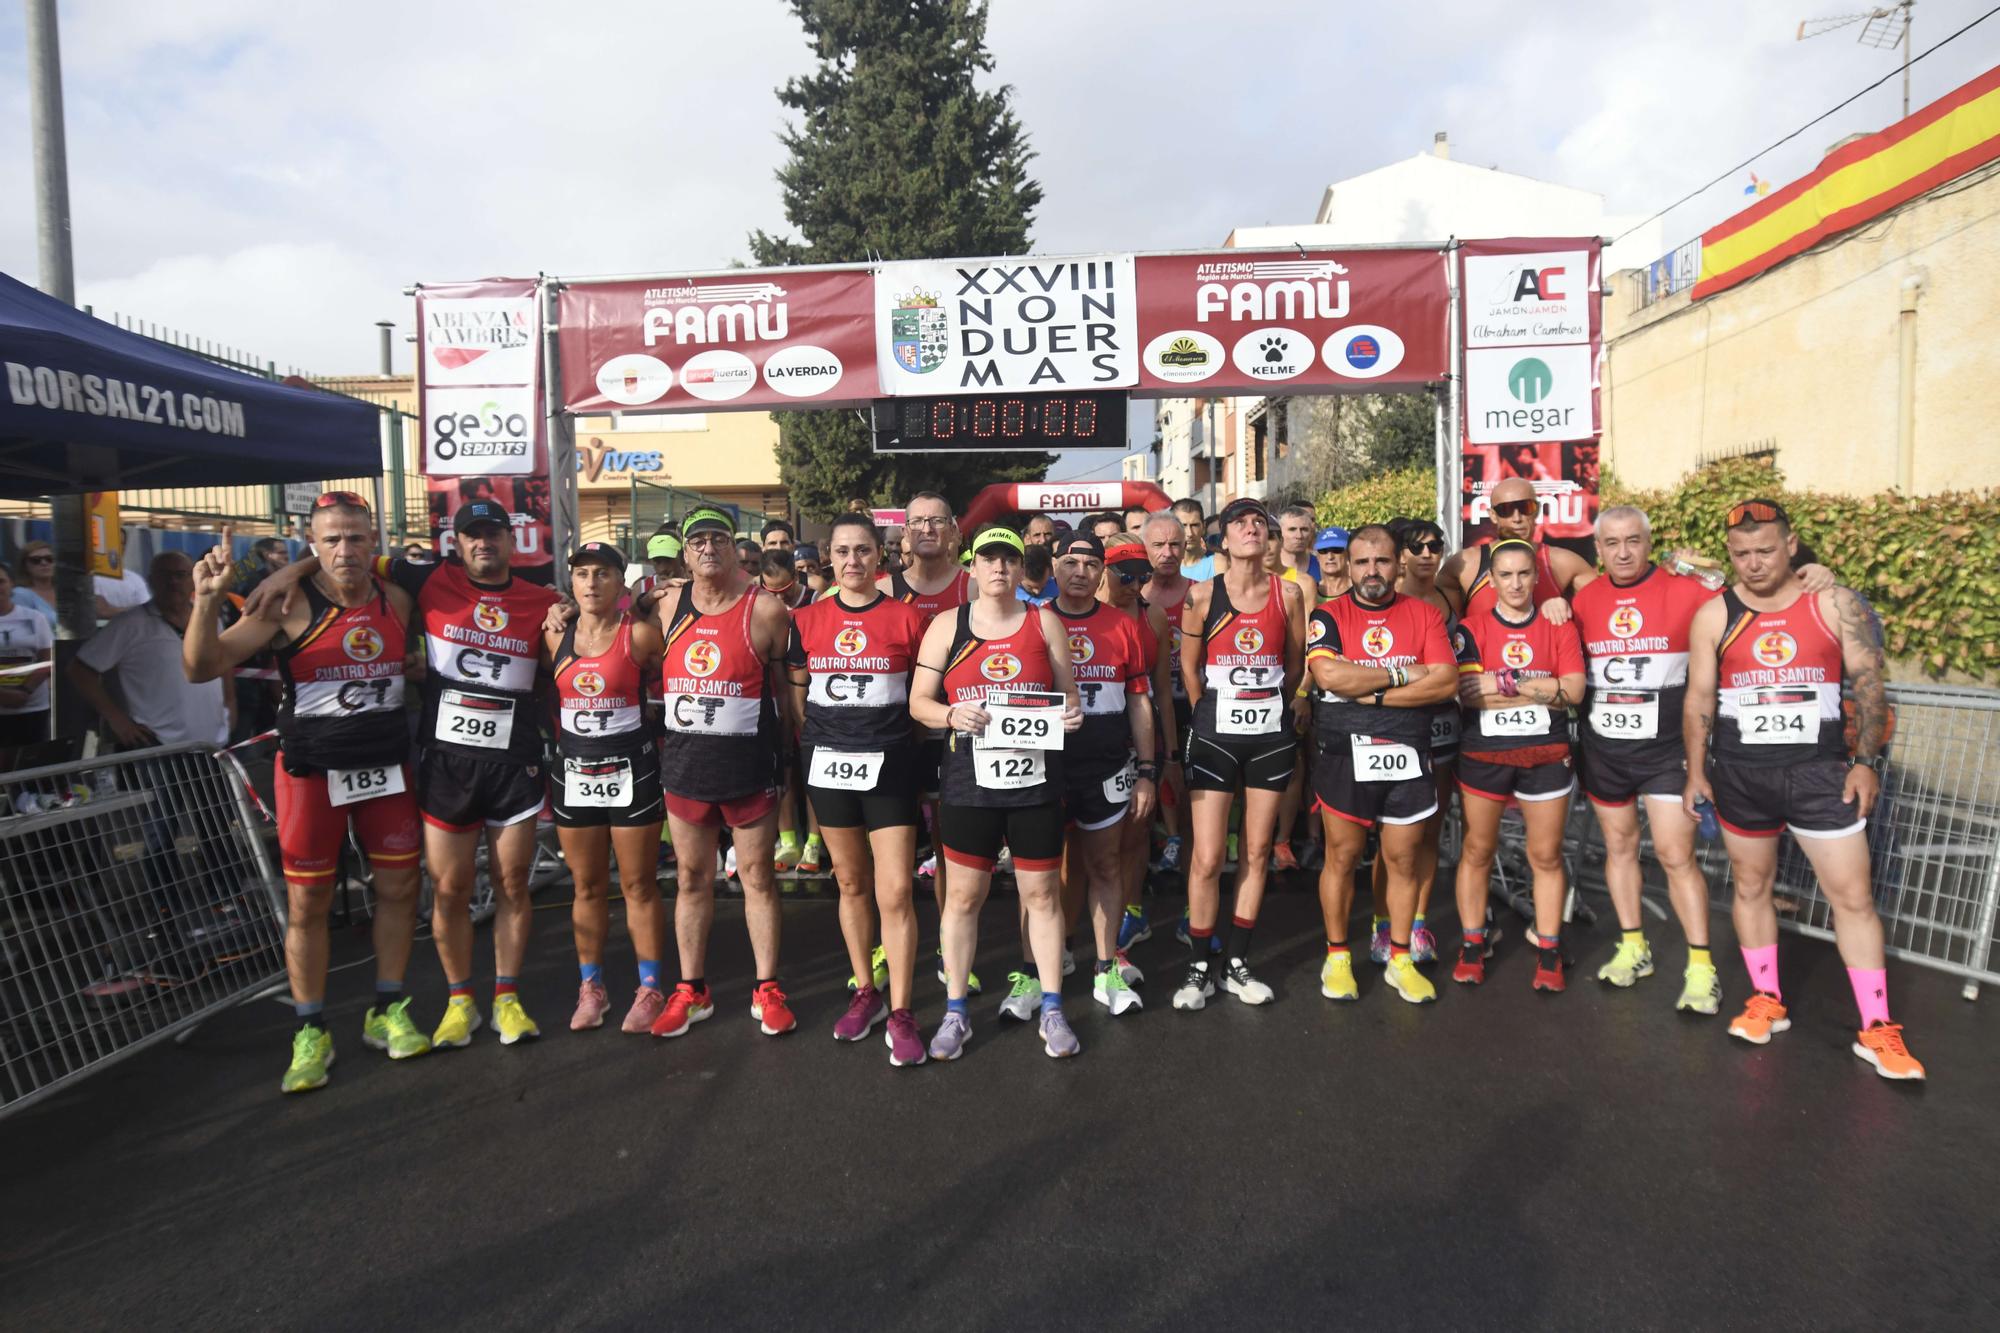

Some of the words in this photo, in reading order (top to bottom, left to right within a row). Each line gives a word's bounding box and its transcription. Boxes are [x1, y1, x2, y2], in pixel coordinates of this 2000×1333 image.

[1196, 262, 1254, 274] ATLETISMO
[1197, 274, 1220, 282] Región
[956, 262, 1114, 296] XXVIII
[1514, 267, 1566, 302] AC
[644, 286, 697, 299] ATLETISMO
[1197, 280, 1349, 322] FAMU
[513, 311, 525, 326] &
[644, 303, 788, 347] FAMU
[961, 324, 1120, 356] DUER
[1474, 324, 1527, 338] Abraham
[1533, 322, 1583, 336] Cambres
[768, 367, 786, 378] LA
[786, 365, 838, 377] VERDAD
[960, 354, 1120, 387] MAS
[1252, 365, 1296, 376] KELME
[4, 361, 246, 438] DORSAL21.COM
[1486, 407, 1575, 434] megar
[462, 442, 526, 456] SPORTS
[1040, 493, 1101, 508] FAMU
[1470, 495, 1582, 525] FMU
[443, 624, 486, 645] CUATRO
[488, 635, 529, 654] SANTOS
[1588, 639, 1626, 654] CUATRO
[1628, 636, 1670, 652] SANTOS
[456, 648, 512, 681] CT
[810, 656, 847, 670] CUATRO
[850, 656, 890, 670] SANTOS
[1216, 654, 1248, 666] CUATRO
[1250, 654, 1278, 666] SANTOS
[1604, 656, 1652, 684] CT
[315, 664, 366, 682] CUATRO
[1081, 665, 1116, 678] SANTOS
[1229, 666, 1269, 686] CT
[1732, 669, 1776, 687] CUATRO
[1779, 667, 1826, 682] SANTOS
[338, 678, 392, 710] CT
[699, 678, 743, 697] SANTOS
[825, 673, 874, 702] CT
[592, 696, 627, 708] SANTOS
[674, 694, 726, 727] CT
[574, 710, 614, 734] CT
[1231, 708, 1271, 725] 507
[1495, 710, 1536, 726] 643
[1602, 713, 1642, 729] 393
[1754, 714, 1805, 734] 284
[451, 716, 497, 738] 298
[1001, 717, 1049, 738] 629
[823, 761, 868, 780] 494
[990, 758, 1034, 778] 122
[1368, 754, 1407, 770] 200
[341, 768, 388, 792] 183
[578, 782, 621, 798] 346
